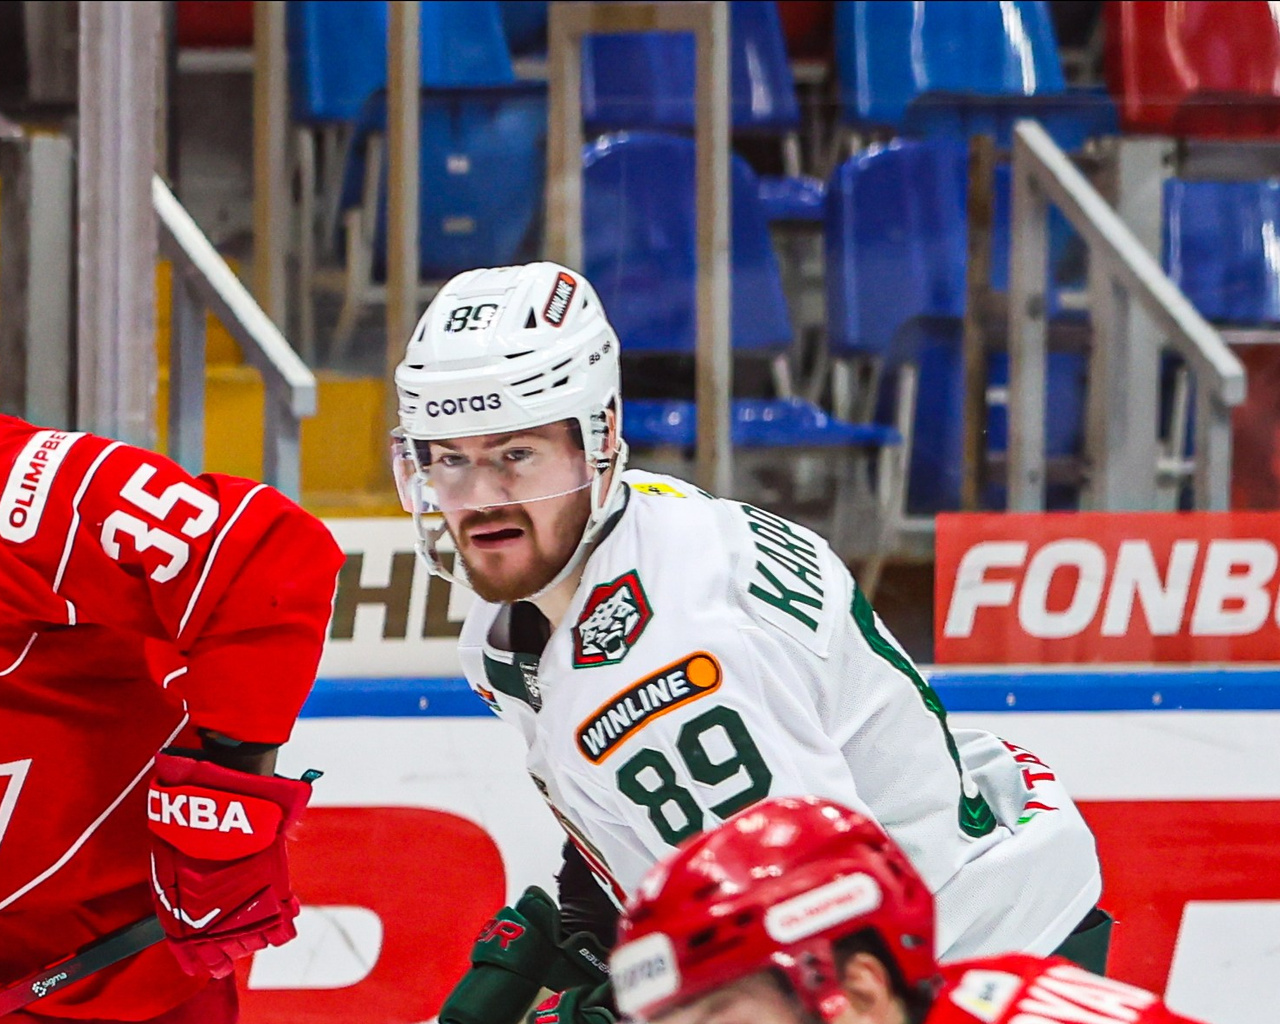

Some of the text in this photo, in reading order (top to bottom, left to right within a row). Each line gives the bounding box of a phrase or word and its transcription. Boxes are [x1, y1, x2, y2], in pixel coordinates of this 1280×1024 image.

[444, 303, 499, 333] 89
[425, 393, 502, 418] согаз
[100, 462, 220, 584] 35
[740, 504, 825, 633] KARP
[943, 536, 1280, 638] FONB
[582, 670, 691, 756] WINLINE
[147, 788, 254, 835] СКВА
[615, 704, 773, 848] 89
